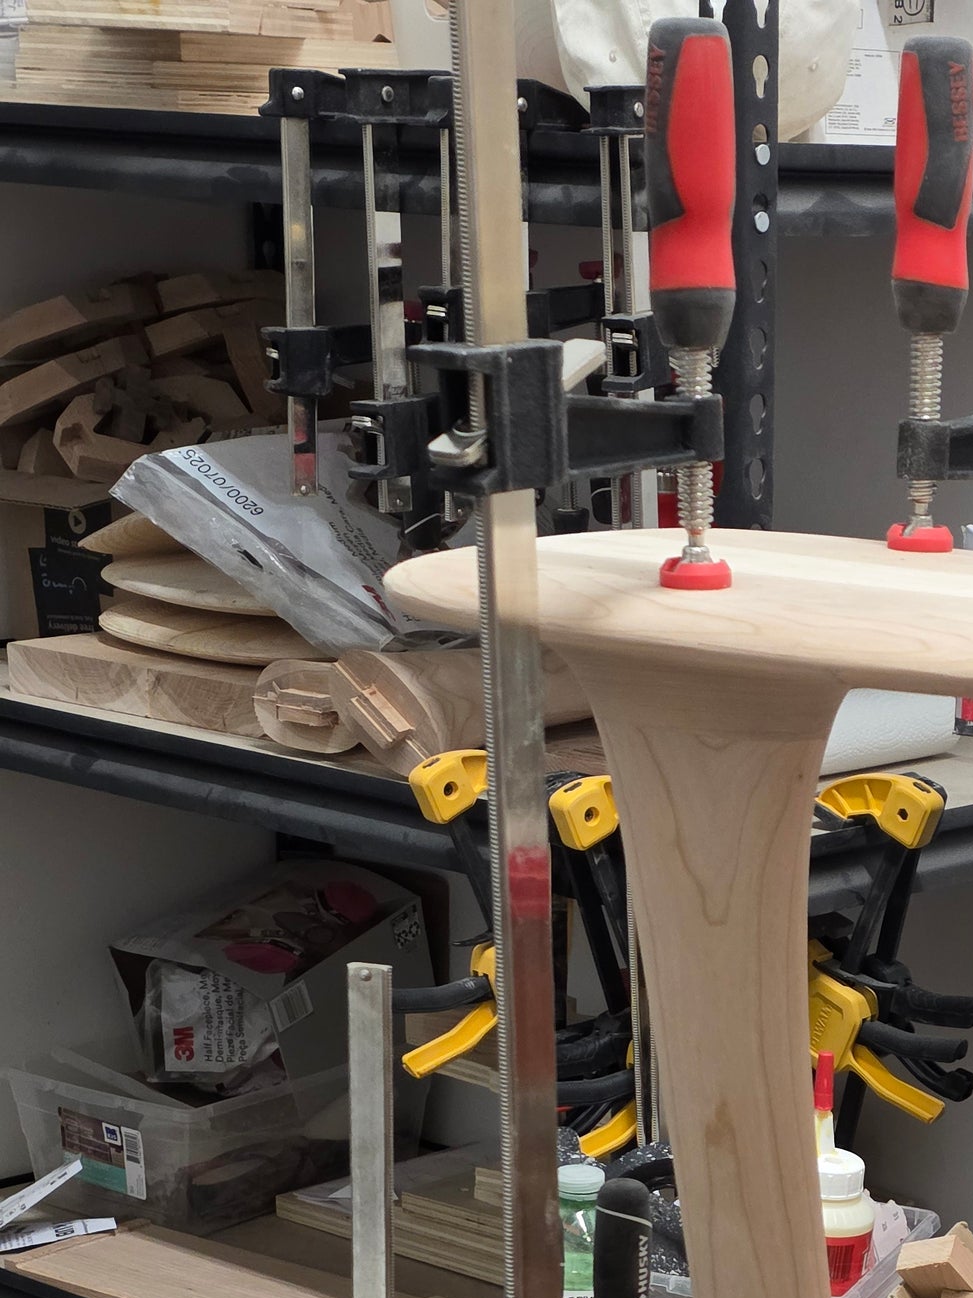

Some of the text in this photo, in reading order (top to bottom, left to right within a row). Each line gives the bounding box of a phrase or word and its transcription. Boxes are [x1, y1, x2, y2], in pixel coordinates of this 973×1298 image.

[949, 61, 968, 142] BESSEY
[183, 449, 264, 516] 6200/07025
[173, 1026, 195, 1062] 3M
[203, 1042, 213, 1062] Half
[638, 1235, 649, 1293] HUSKY
